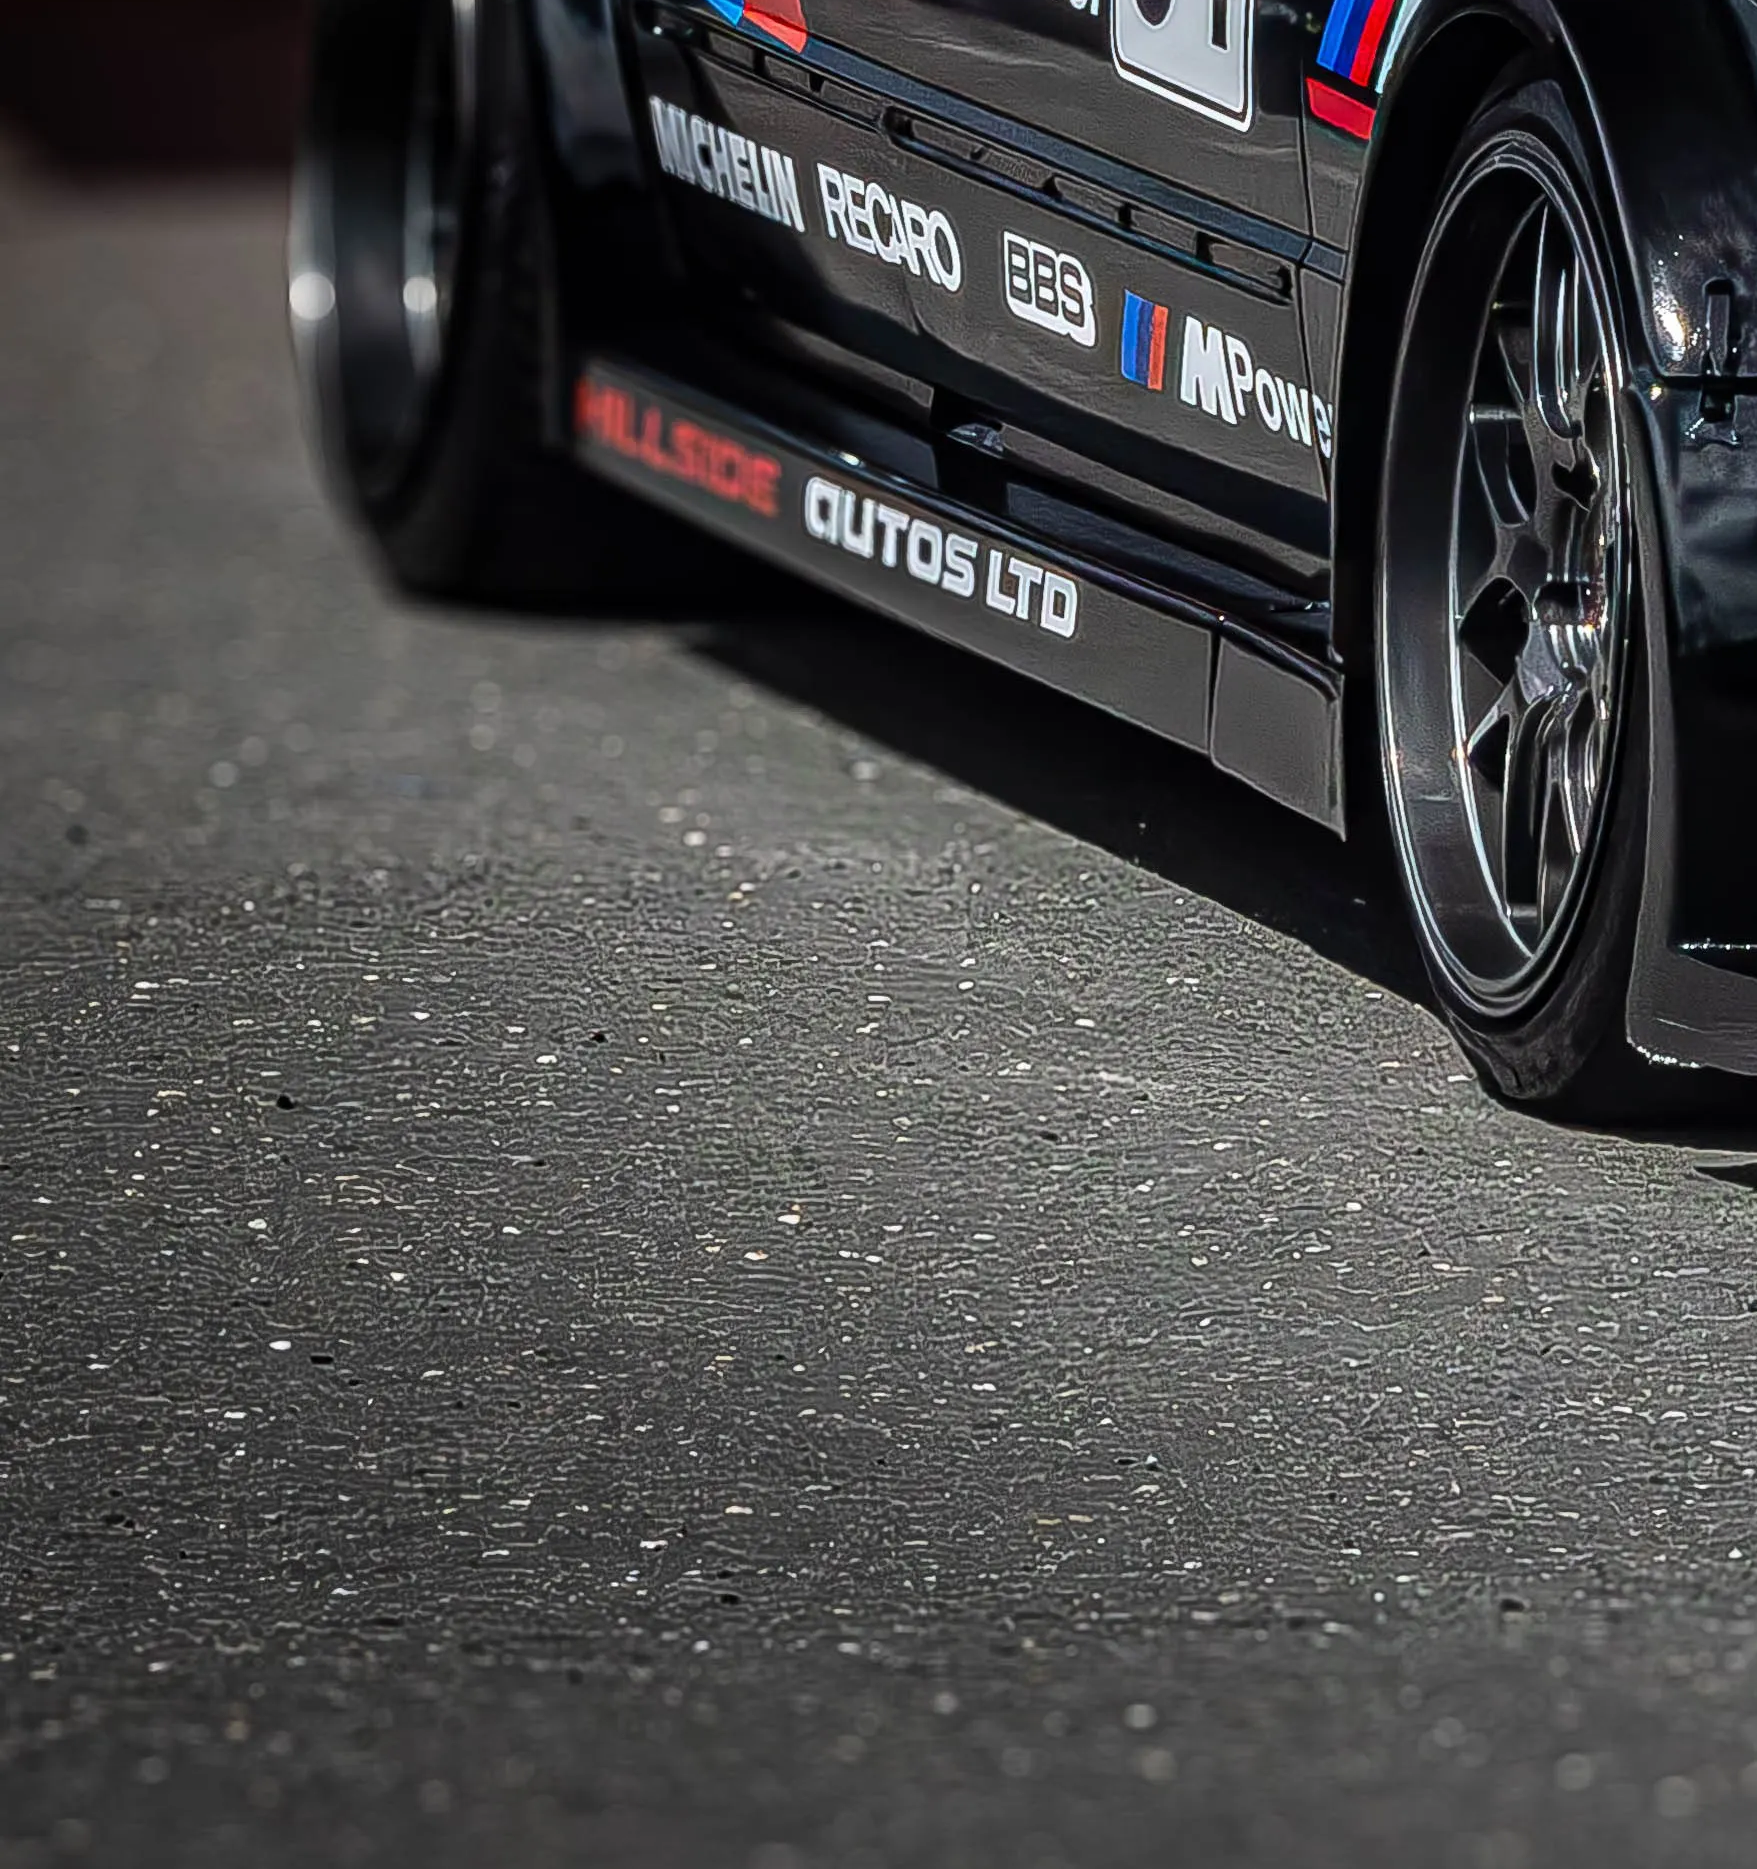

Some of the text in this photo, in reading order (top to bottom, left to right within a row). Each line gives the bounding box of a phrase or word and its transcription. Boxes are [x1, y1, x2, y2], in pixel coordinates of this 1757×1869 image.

[648, 94, 806, 234] MICHELIN
[815, 160, 964, 294] RECARO
[1004, 235, 1093, 343] BBS
[575, 376, 783, 518] HILLSIDE
[984, 547, 1078, 638] LTD
